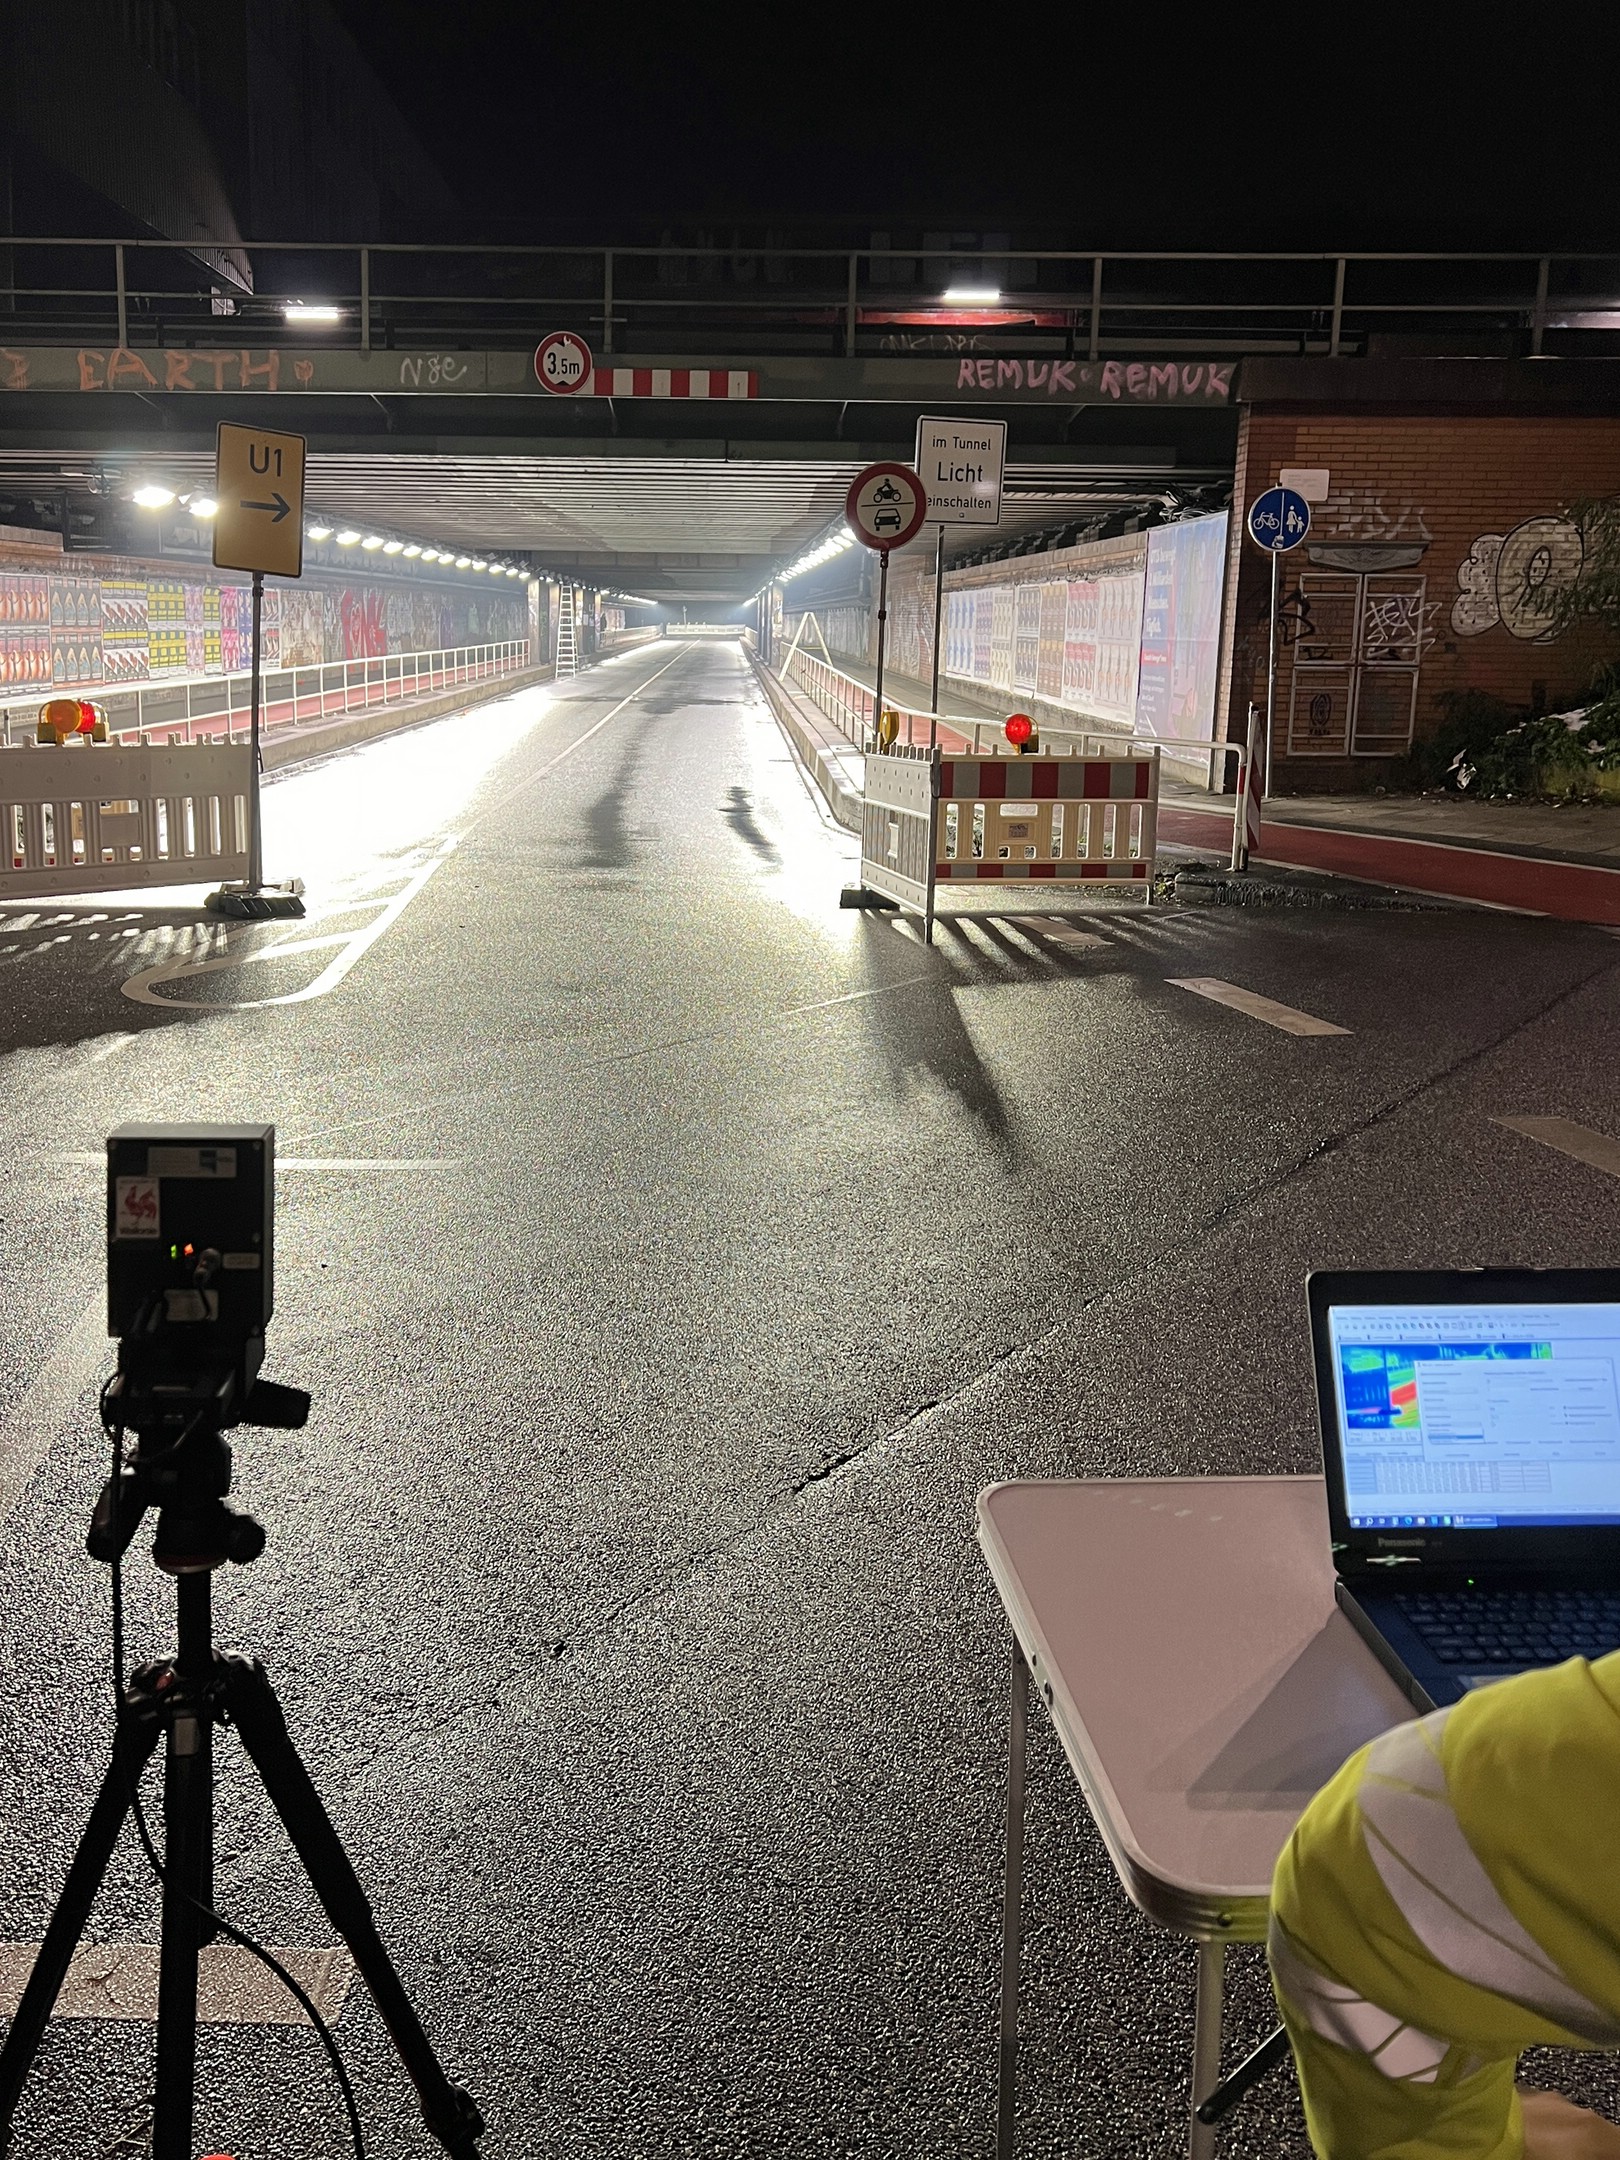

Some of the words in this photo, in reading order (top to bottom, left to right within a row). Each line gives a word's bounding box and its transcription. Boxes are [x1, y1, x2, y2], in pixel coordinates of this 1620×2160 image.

[77, 347, 281, 391] EARTH
[547, 351, 580, 376] 3.5m
[957, 359, 1077, 394] REMUK
[1101, 360, 1230, 400] REMUK
[932, 435, 947, 448] im
[953, 436, 991, 451] Tunnel
[250, 444, 282, 477] U1
[937, 461, 983, 483] Licht
[927, 494, 992, 509] einschalten
